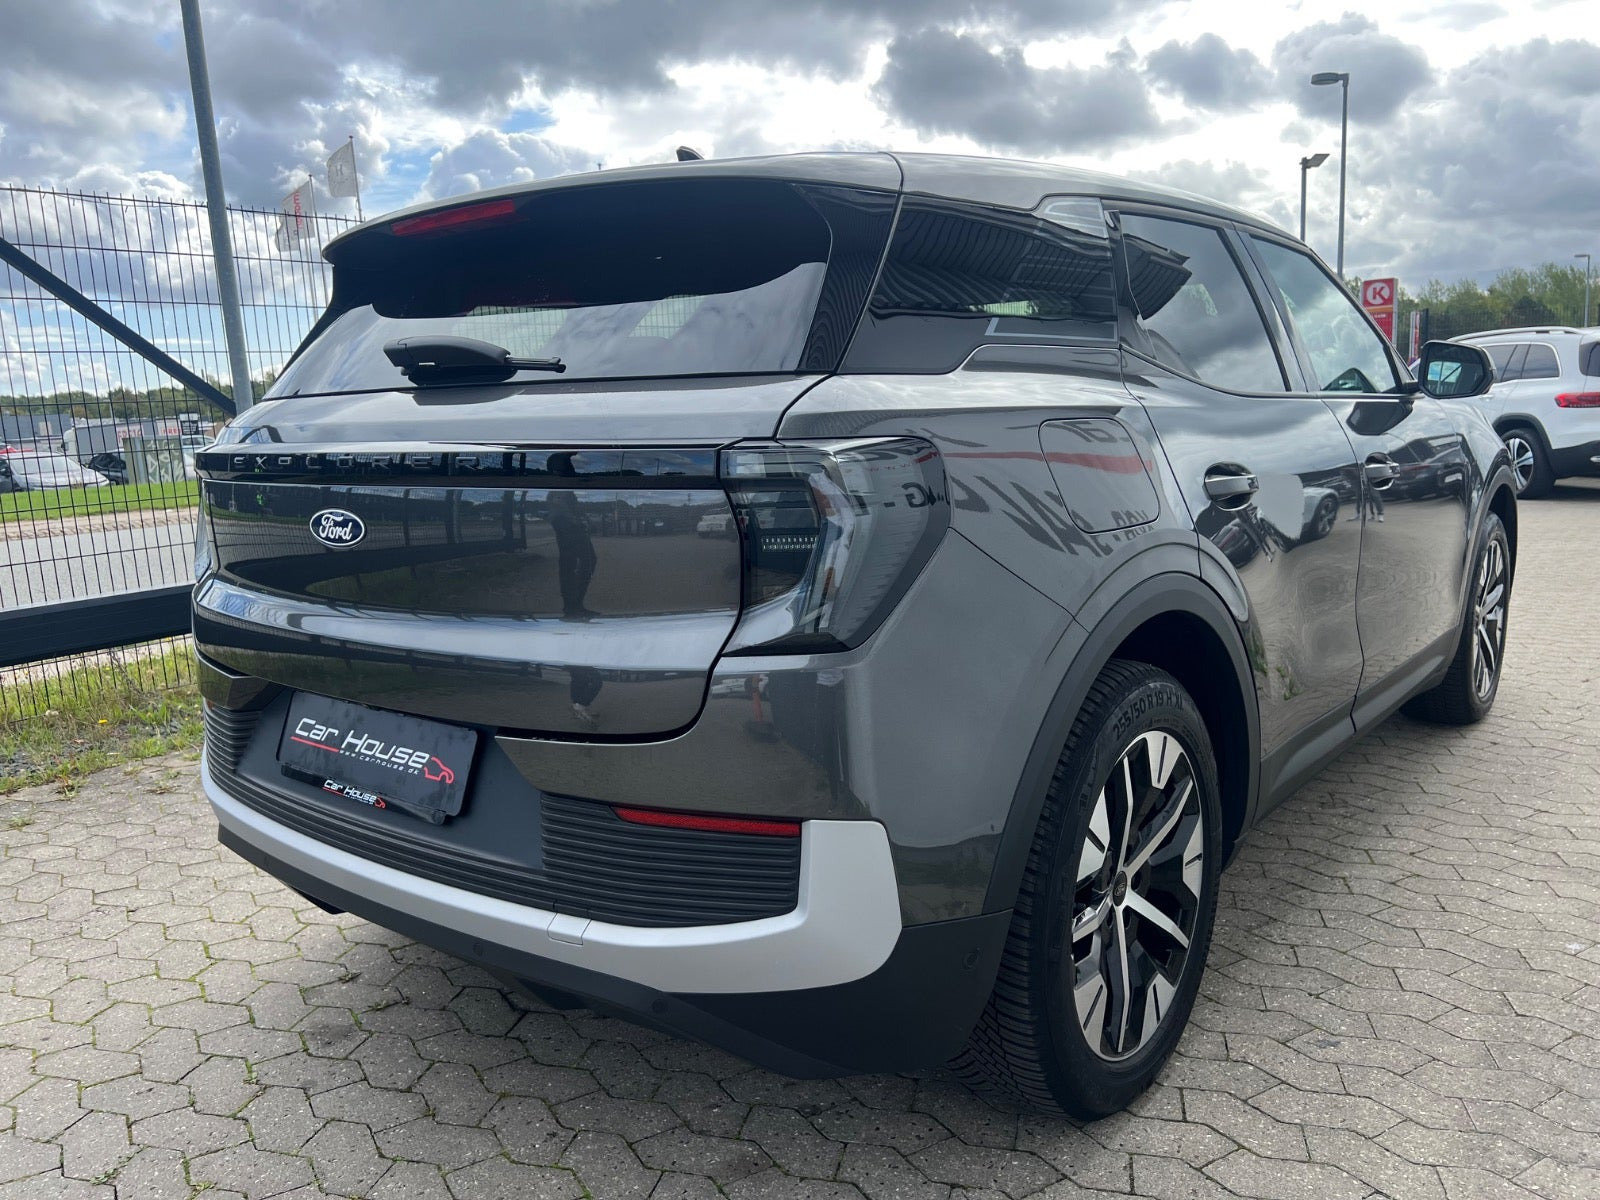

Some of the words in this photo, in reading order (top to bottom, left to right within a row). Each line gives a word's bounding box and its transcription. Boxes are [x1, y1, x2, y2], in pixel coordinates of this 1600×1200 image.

[319, 514, 353, 541] Ford
[1113, 697, 1147, 740] 255/50
[295, 717, 339, 742] Car
[341, 729, 430, 769] House
[323, 779, 343, 792] Car
[343, 785, 377, 801] House
